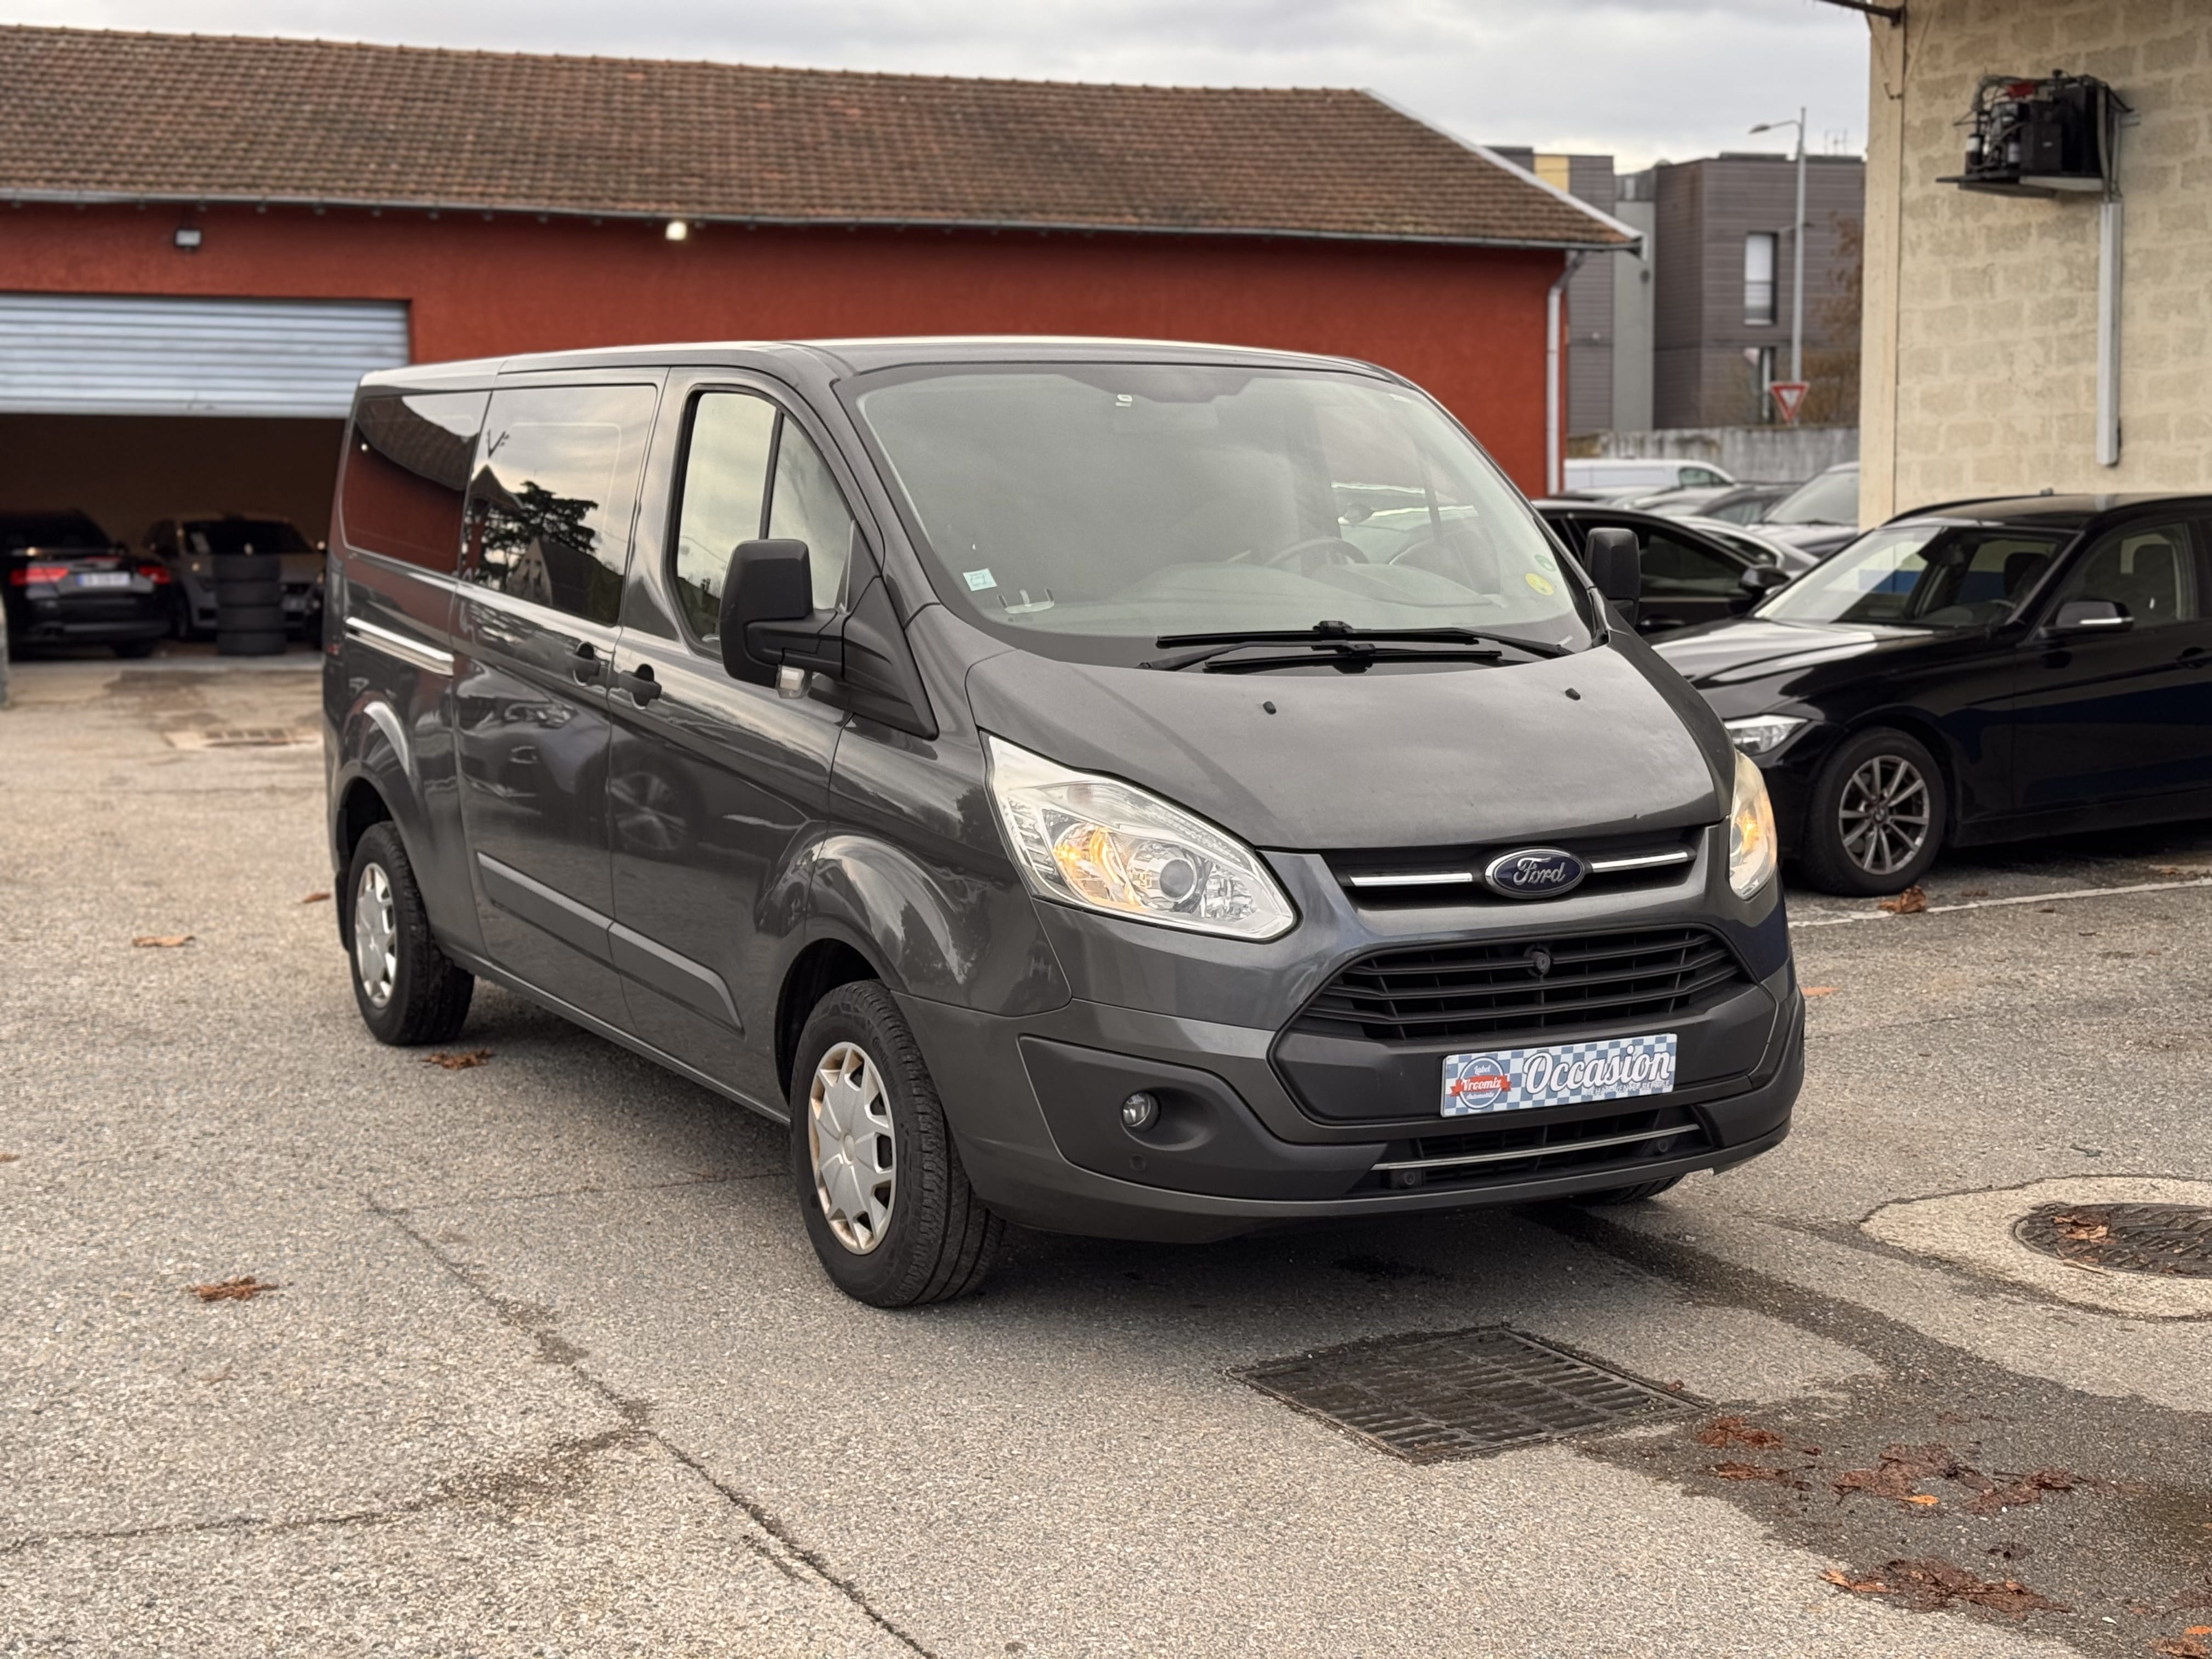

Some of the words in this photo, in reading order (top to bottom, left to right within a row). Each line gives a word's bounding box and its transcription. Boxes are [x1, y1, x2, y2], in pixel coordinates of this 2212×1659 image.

[1513, 857, 1565, 885] Ford
[1474, 1064, 1492, 1075] Label
[1523, 1045, 1670, 1094] Occasion
